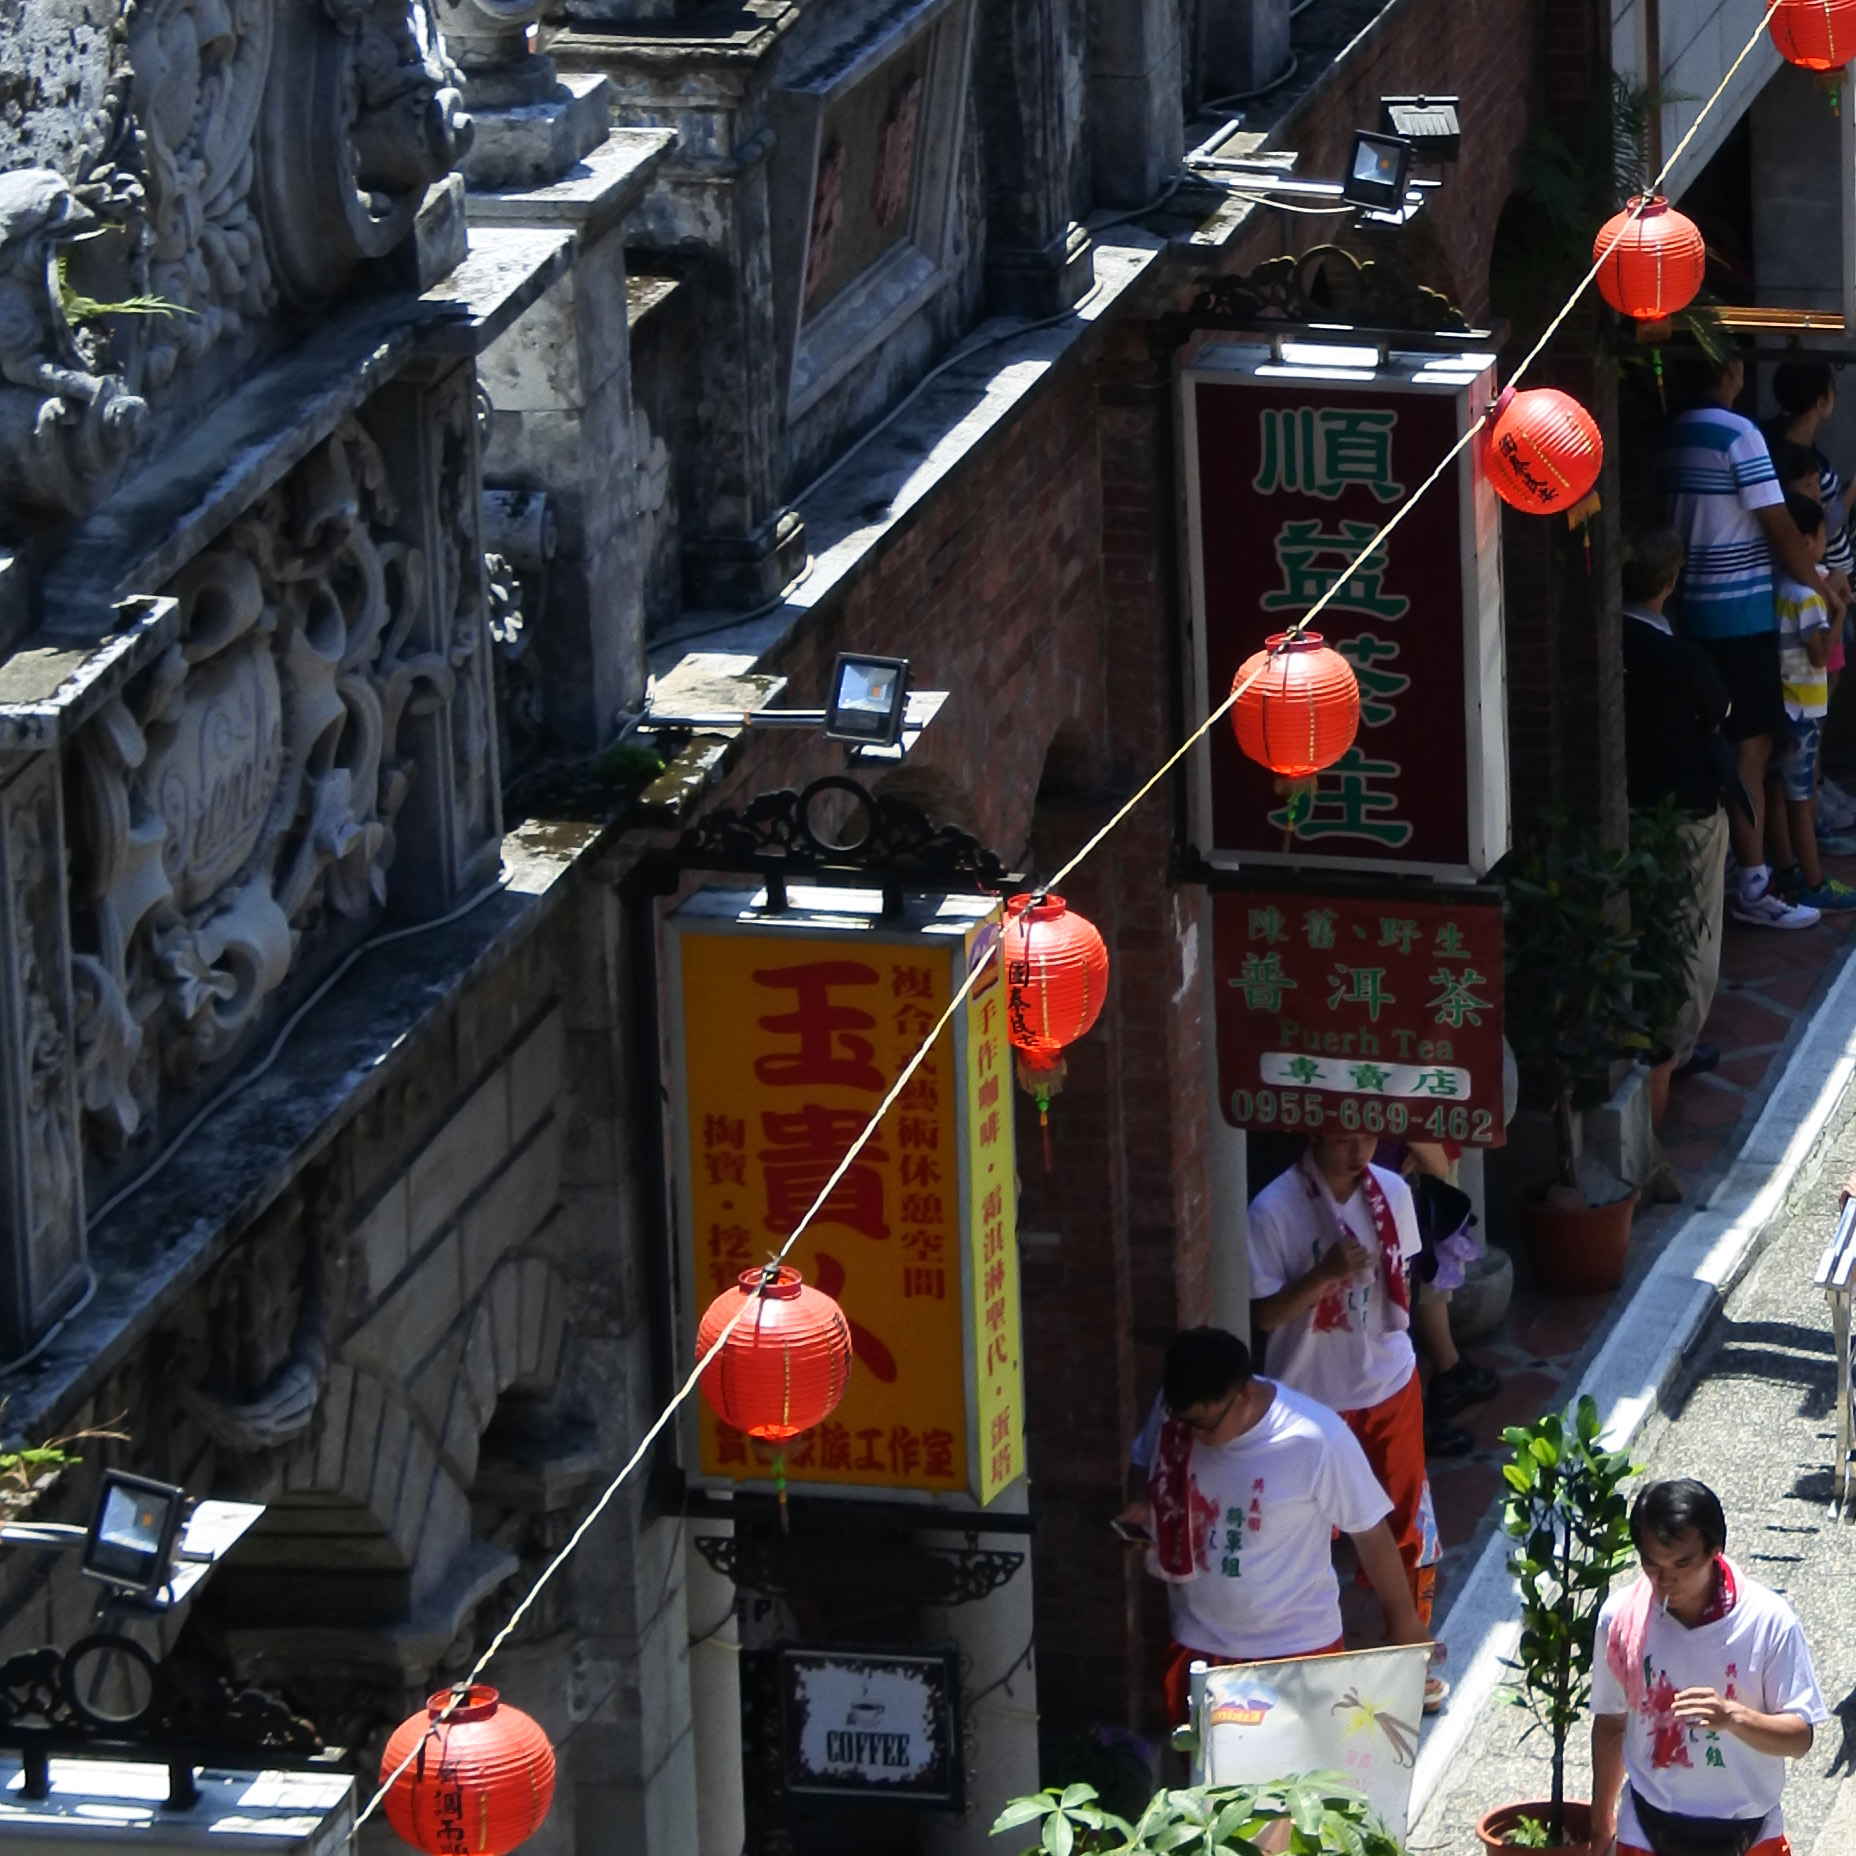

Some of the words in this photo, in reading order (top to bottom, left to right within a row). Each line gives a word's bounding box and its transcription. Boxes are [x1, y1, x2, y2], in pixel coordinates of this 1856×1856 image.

[1228, 951, 1494, 1028] 普洱茶
[1280, 1019, 1380, 1056] Puerh
[1391, 1028, 1455, 1062] Tea
[1278, 1055, 1459, 1096] 專賣店
[1231, 1089, 1493, 1142] 0955-669-462
[826, 1729, 910, 1768] COFFEE
